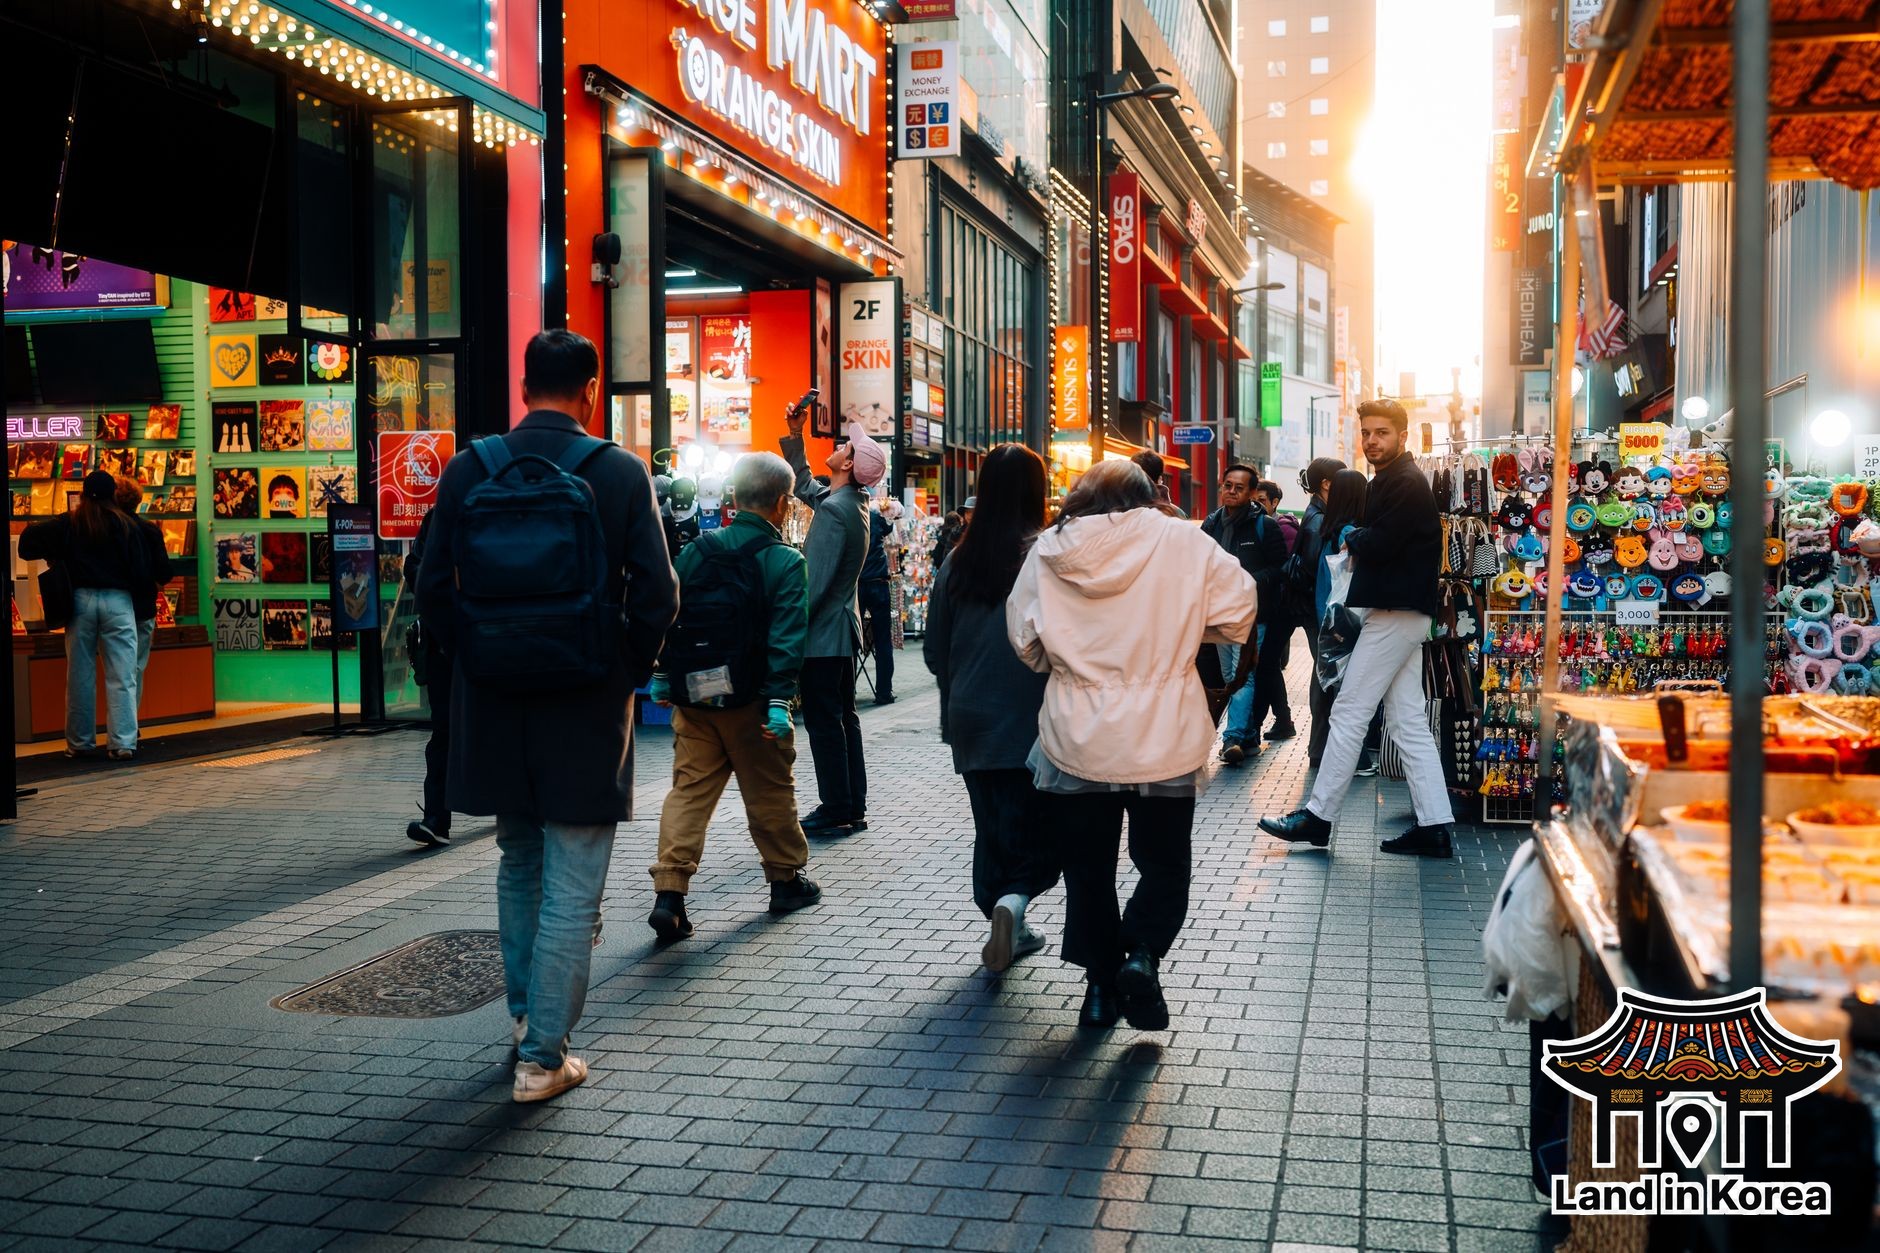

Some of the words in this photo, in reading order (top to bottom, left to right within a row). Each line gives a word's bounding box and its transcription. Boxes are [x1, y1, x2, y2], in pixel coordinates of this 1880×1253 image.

[769, 0, 876, 135] MART
[912, 77, 941, 86] MONEY
[904, 87, 950, 97] EXCHANGE
[683, 37, 793, 157] ORANGE
[796, 113, 840, 186] SKIN
[908, 107, 922, 123] 元
[1505, 193, 1519, 213] 2
[1113, 195, 1135, 264] SPAO
[1527, 212, 1553, 235] JUNO
[236, 310, 254, 319] APT.
[853, 300, 881, 320] 2F
[1519, 277, 1534, 361] MEDIHEAL
[846, 339, 888, 349] ORANGE
[843, 350, 891, 369] SKIN
[1263, 364, 1280, 372] ABC
[1063, 358, 1078, 422] SUNSKIN
[1625, 435, 1659, 448] 5000
[1865, 446, 1879, 455] 1P
[403, 462, 431, 475] TAX
[1865, 458, 1879, 467] 2P
[404, 476, 432, 486] FREE
[393, 503, 436, 517] 即刻退
[335, 519, 353, 530] K-POP
[214, 598, 259, 618] YOU
[1618, 610, 1651, 620] 3,000
[235, 614, 257, 629] the
[215, 630, 260, 650] HAD
